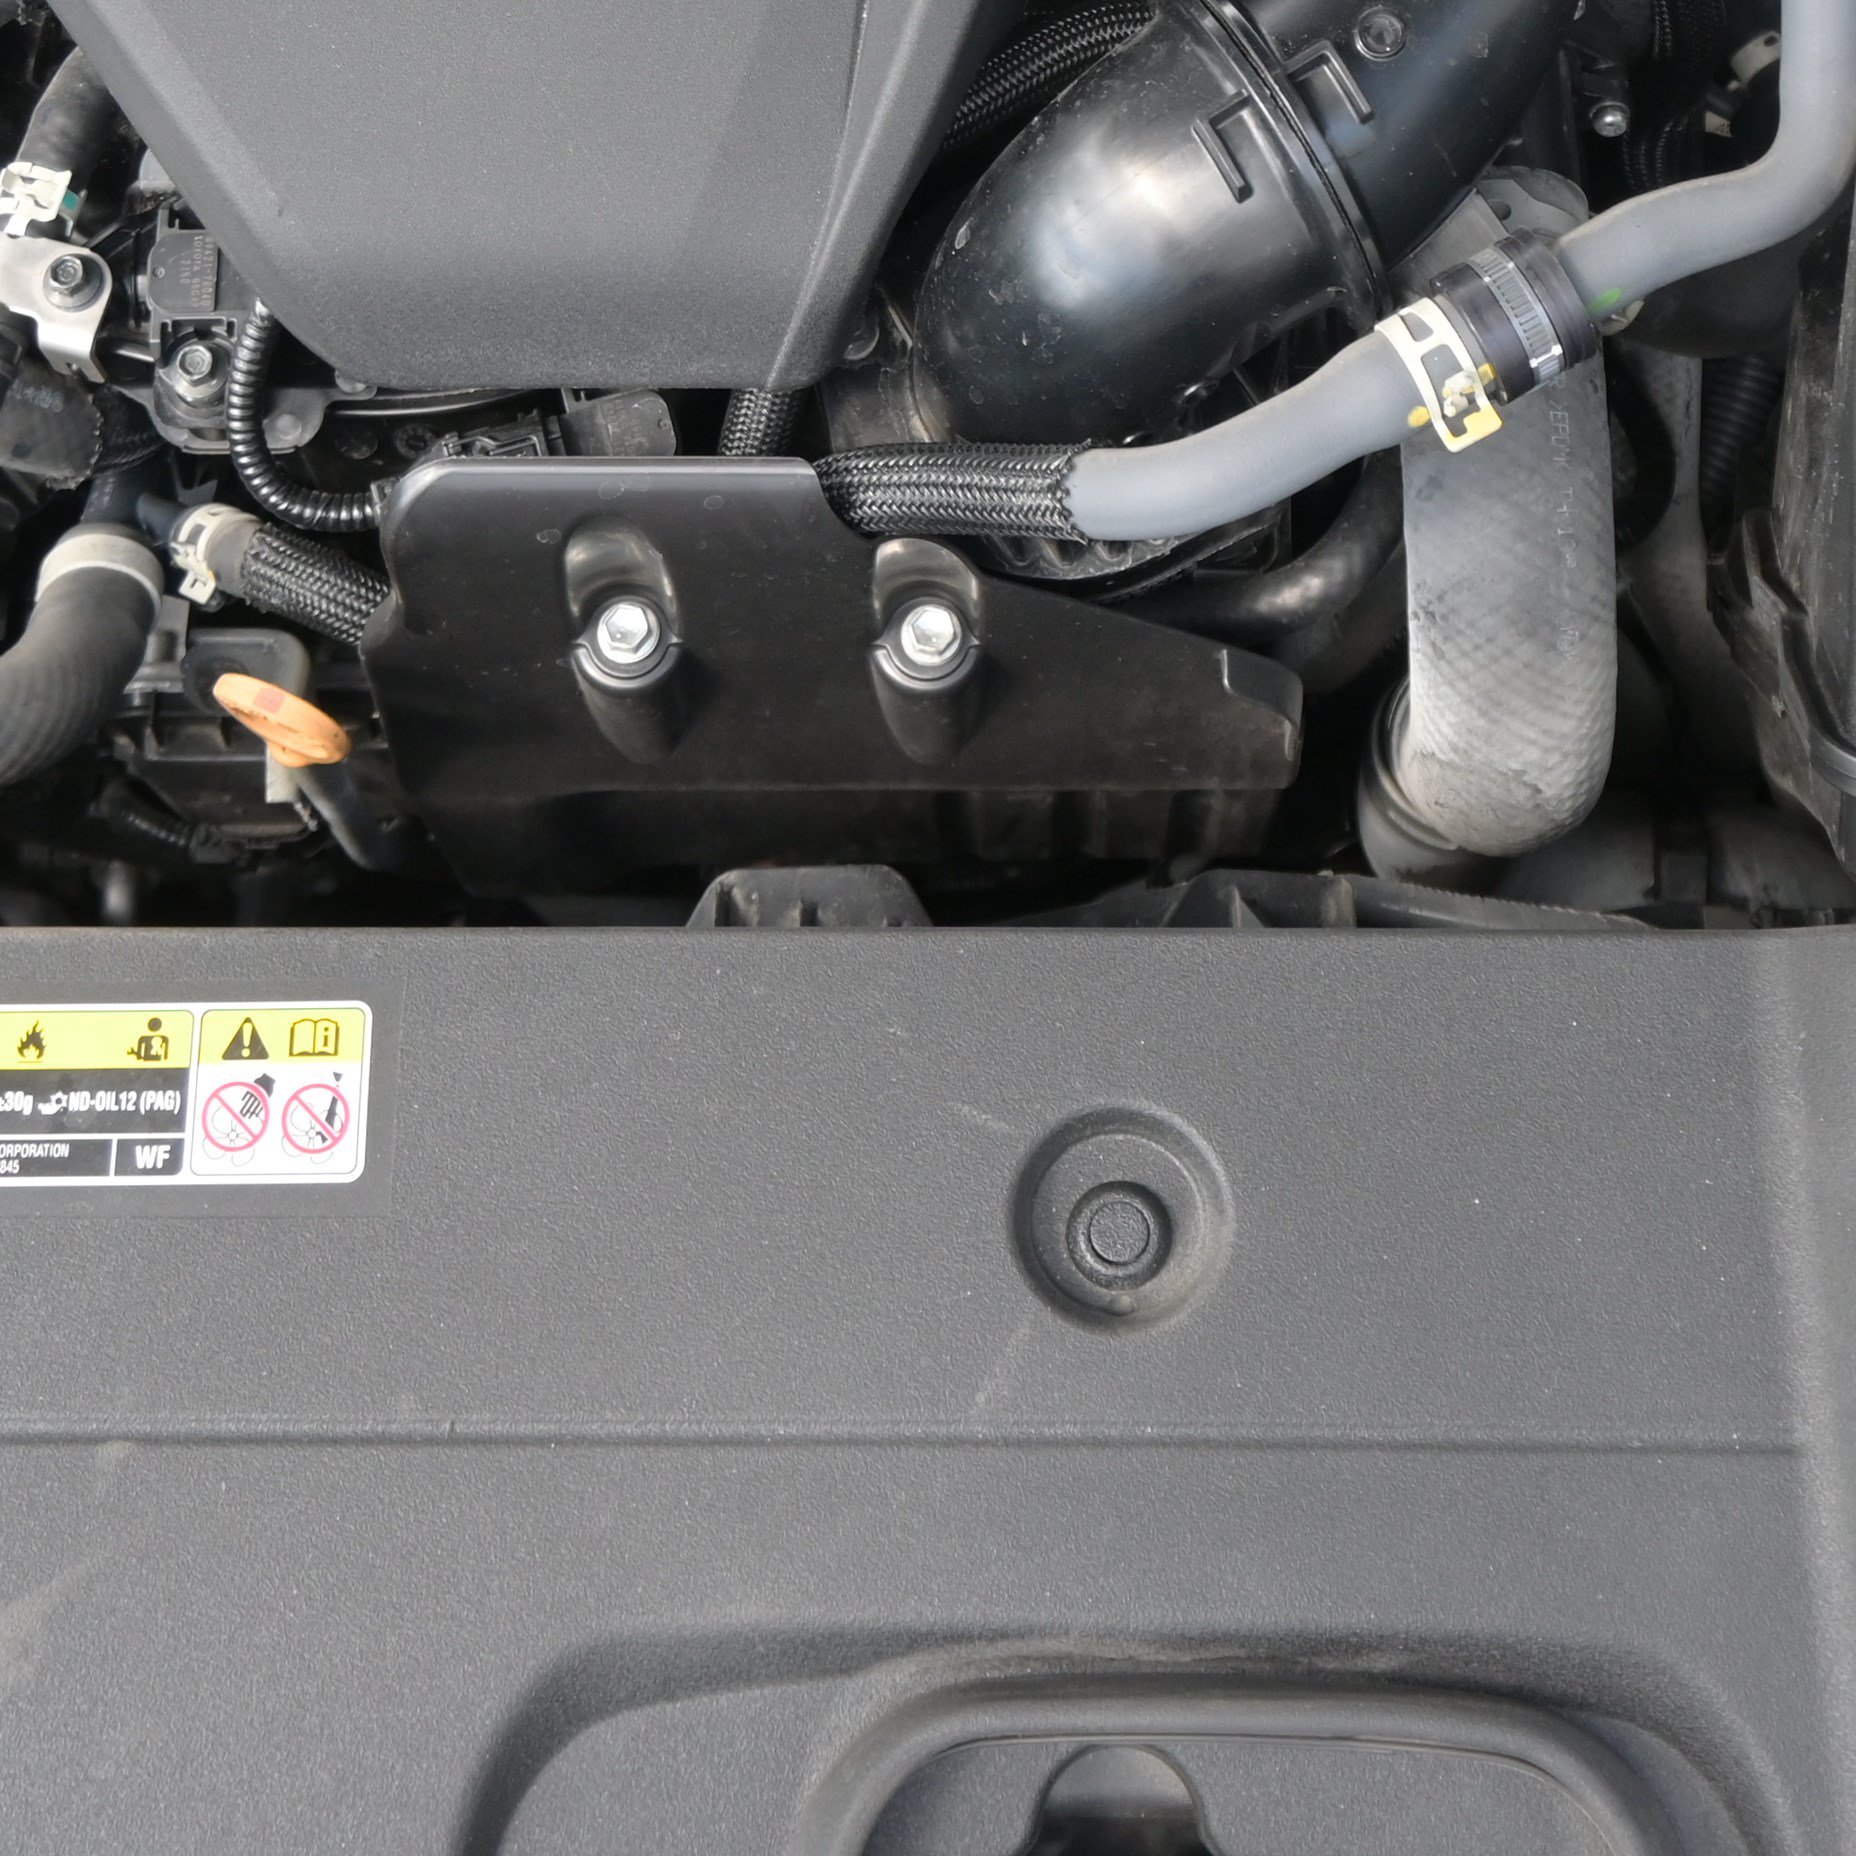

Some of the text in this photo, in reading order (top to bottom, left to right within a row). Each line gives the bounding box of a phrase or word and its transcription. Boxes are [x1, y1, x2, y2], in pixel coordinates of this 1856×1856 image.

[67, 1090, 136, 1112] ND-OIL12
[139, 1090, 181, 1115] (PAG)
[135, 1145, 171, 1169] WF
